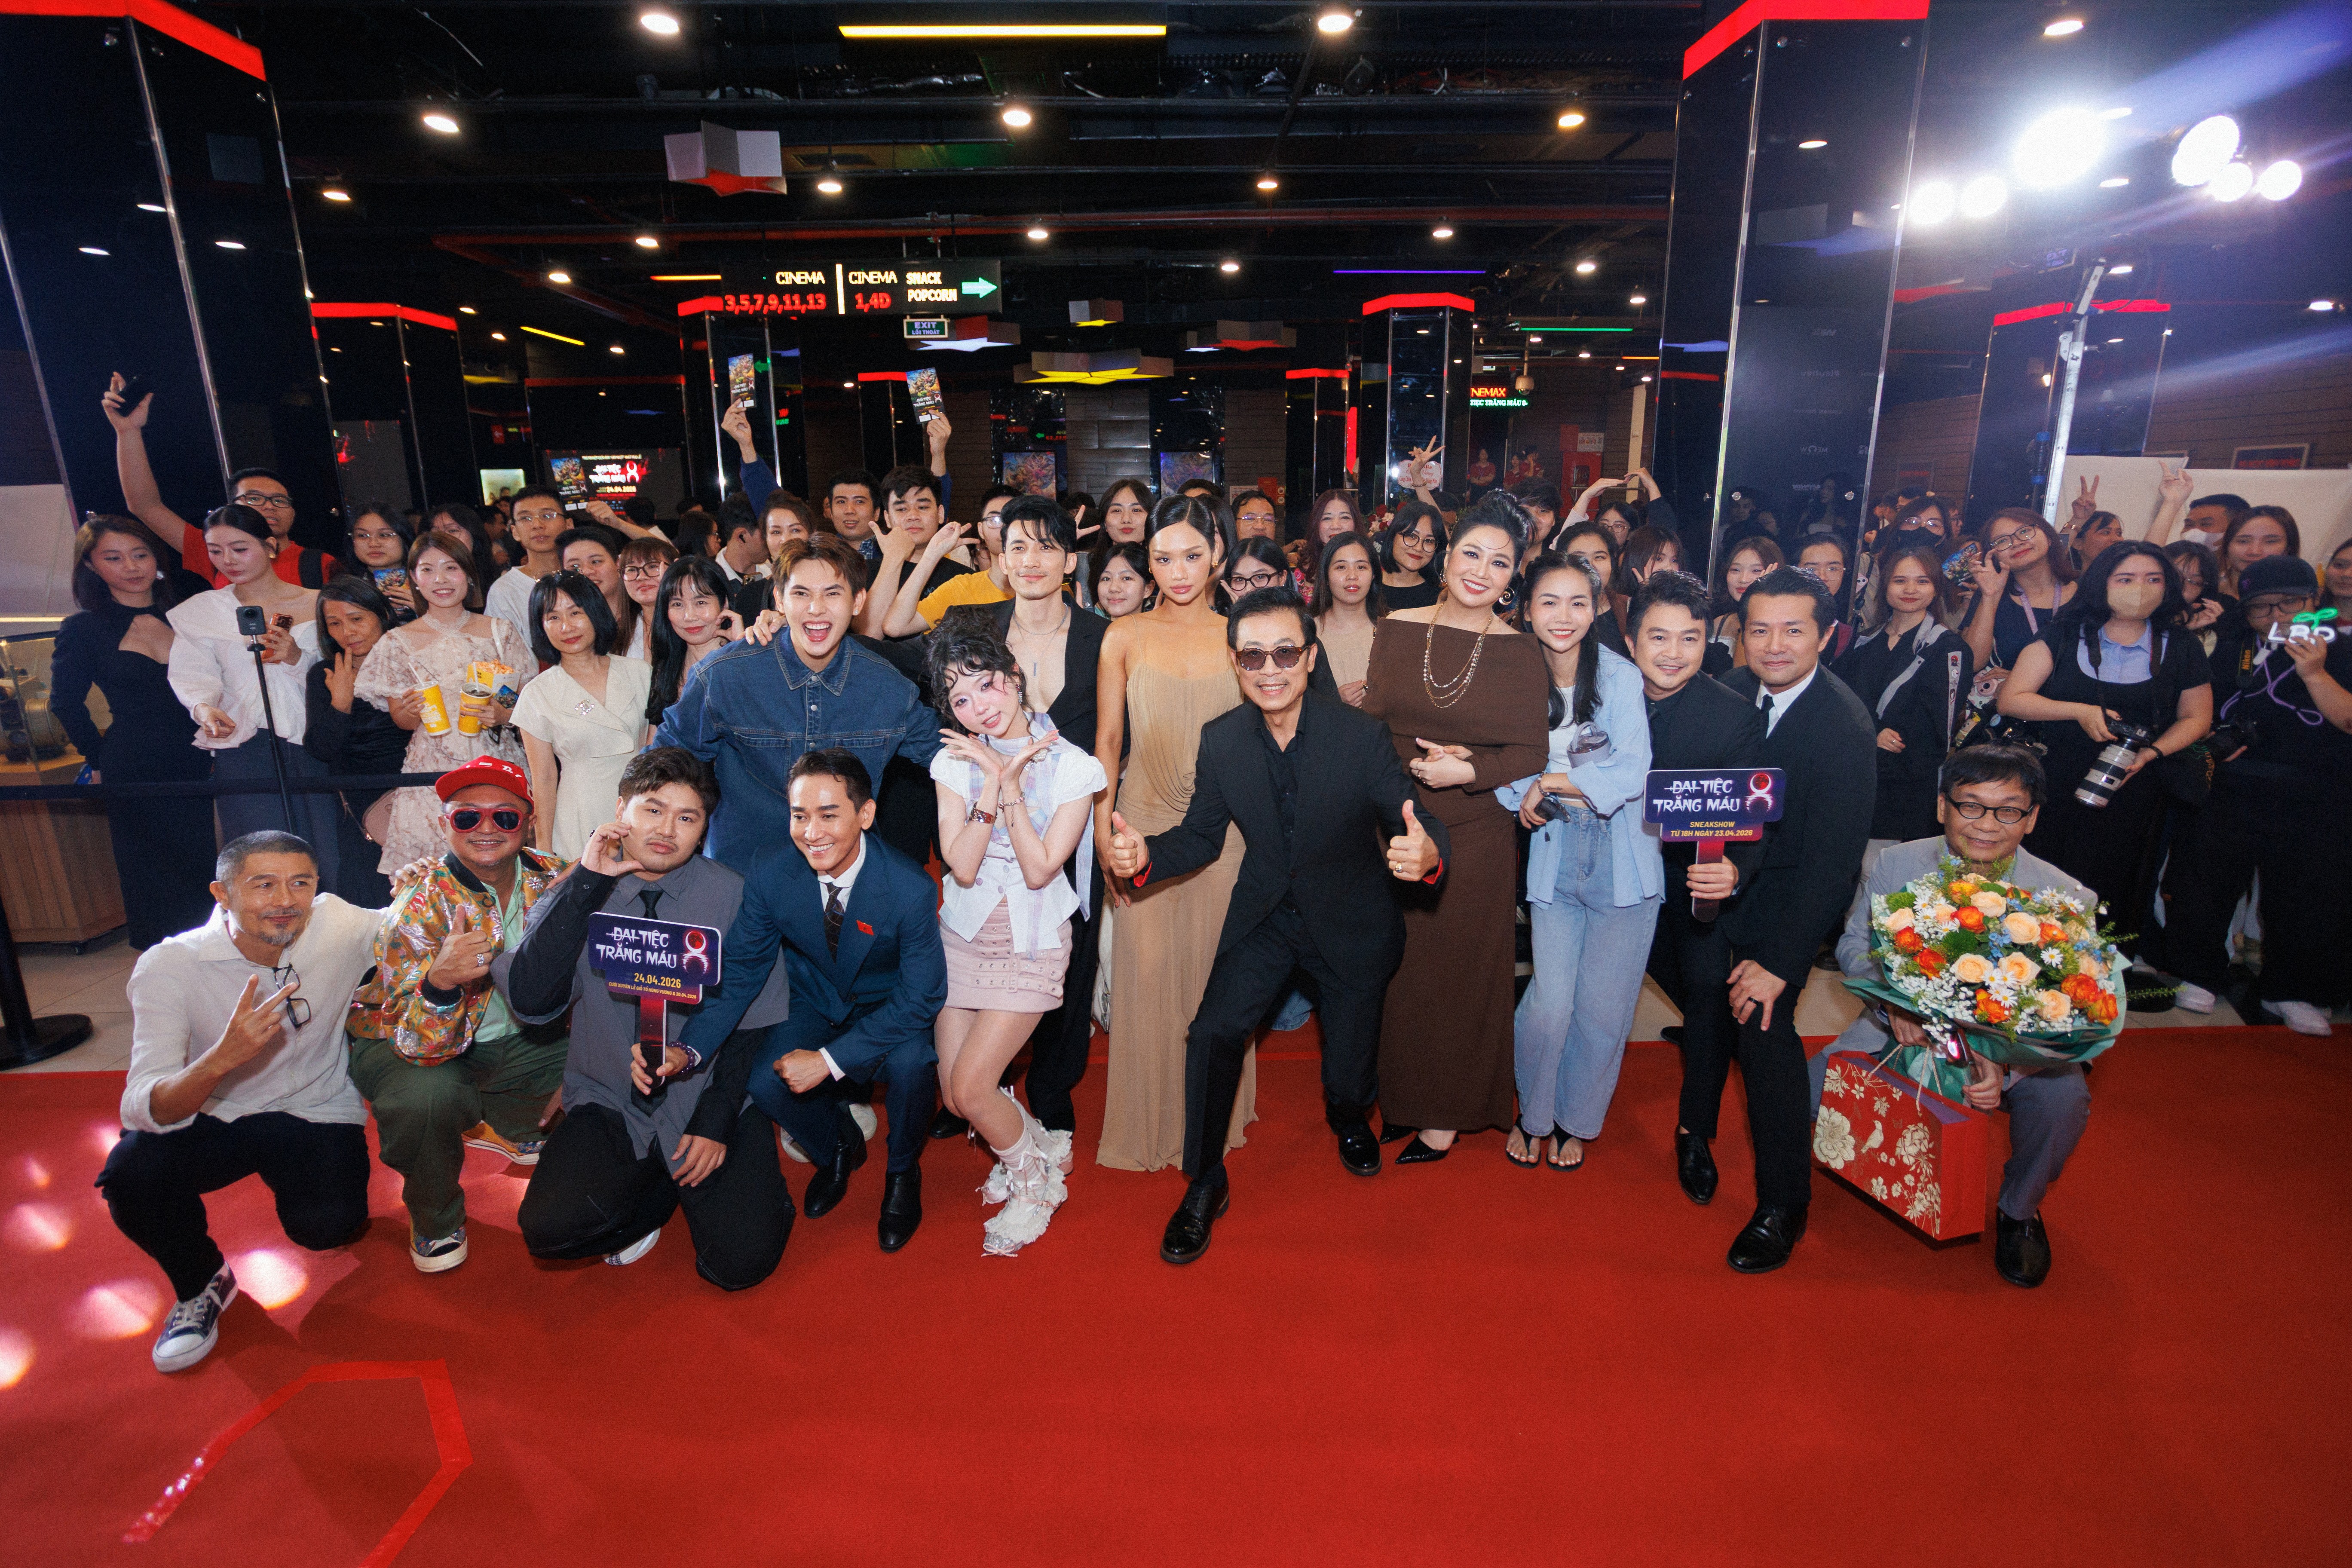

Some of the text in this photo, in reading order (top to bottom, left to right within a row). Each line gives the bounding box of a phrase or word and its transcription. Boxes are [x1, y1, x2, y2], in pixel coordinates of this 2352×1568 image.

[775, 271, 825, 285] CINEMA
[848, 271, 898, 285] CINEMA
[906, 272, 942, 285] SNACK
[725, 293, 826, 315] 3,5,7,9,11,13
[855, 292, 892, 312] 1,4D
[907, 288, 958, 302] POPCORN
[1470, 387, 1507, 397] NEMAX
[2242, 650, 2251, 670] Nikon
[1700, 778, 1733, 796] TIỆC
[1653, 795, 1740, 816] TRĂNG MÁU
[638, 930, 669, 949] TIỆC
[596, 942, 677, 968] TRĂNG MÁU
[634, 972, 681, 989] 24.04.2026
